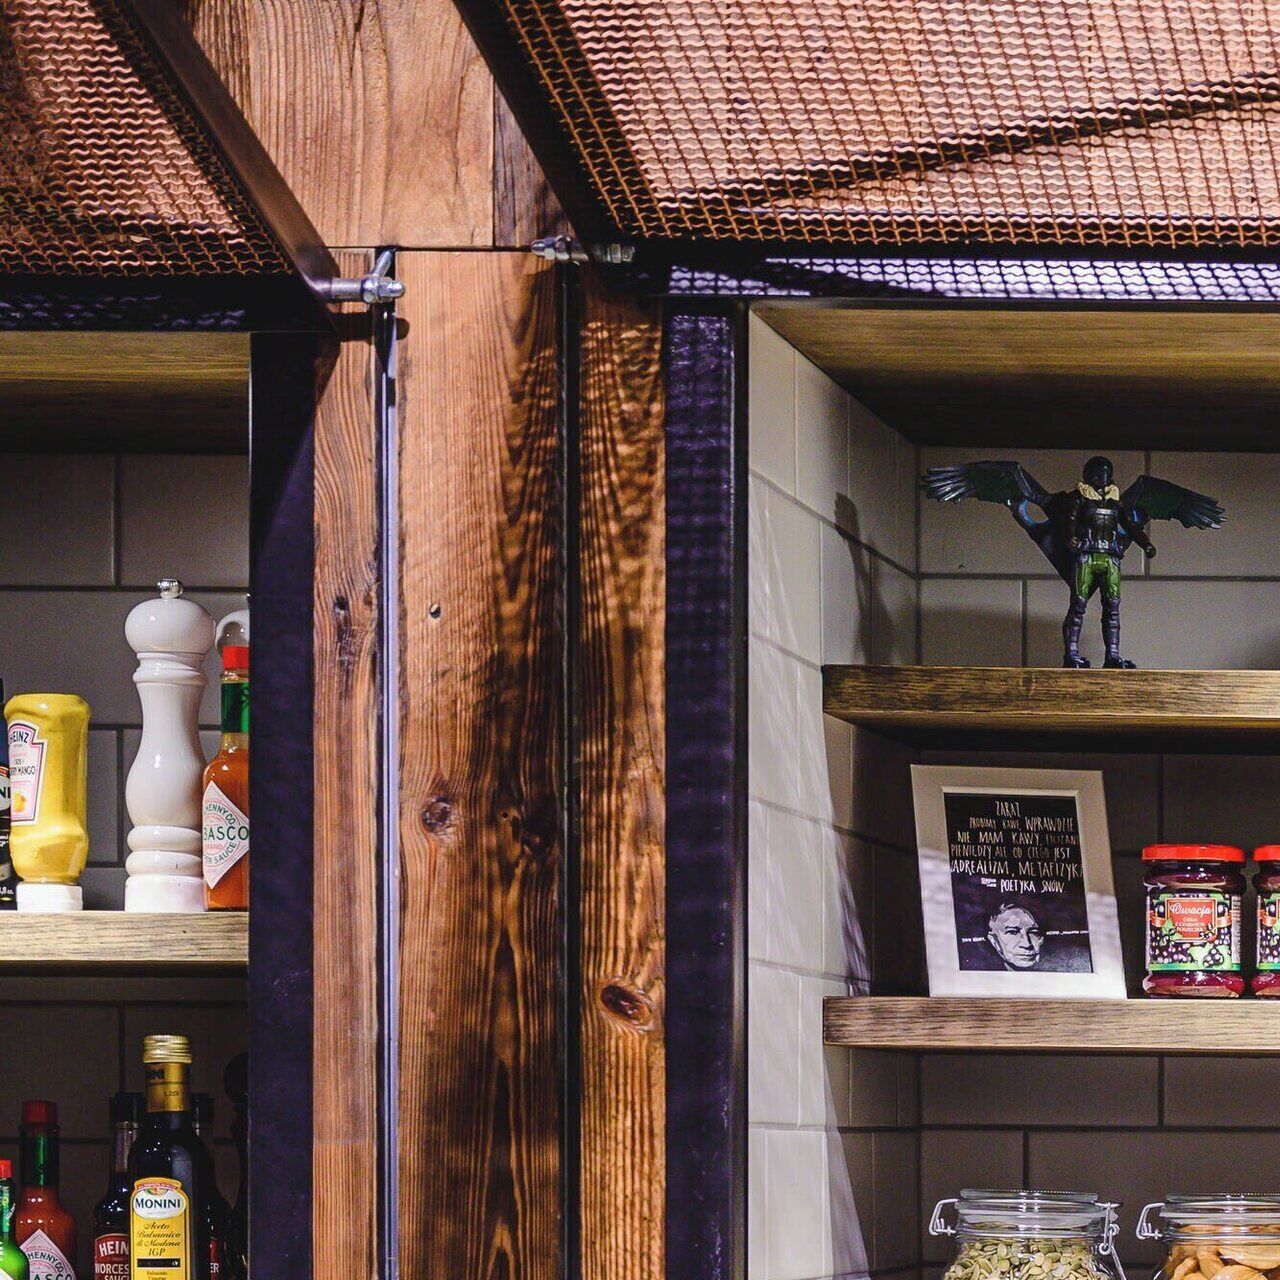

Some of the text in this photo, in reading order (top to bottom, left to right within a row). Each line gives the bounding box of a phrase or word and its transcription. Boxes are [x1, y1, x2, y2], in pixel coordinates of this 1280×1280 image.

[203, 826, 250, 841] BASCO
[957, 831, 970, 843] NIE
[1054, 847, 1071, 862] JEST
[1000, 878, 1036, 894] POETYKA
[135, 1198, 181, 1209] MONINI
[99, 1241, 130, 1257] HEIN
